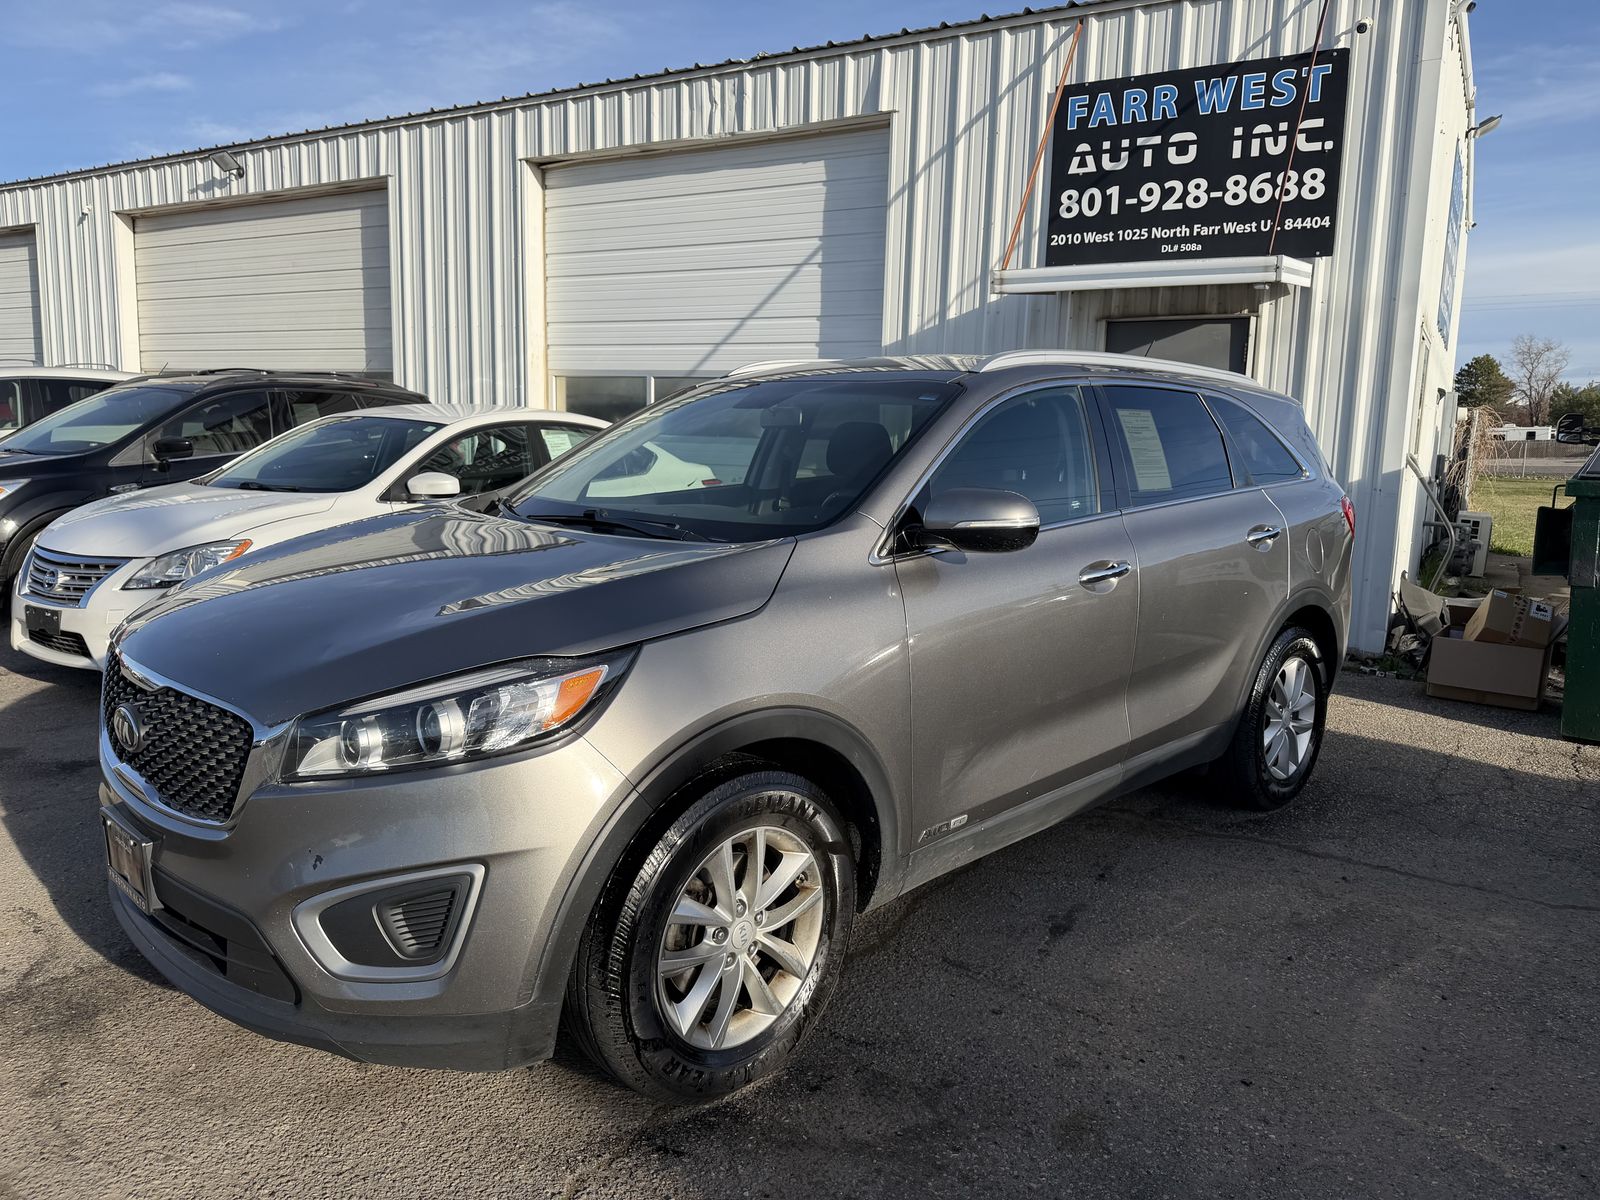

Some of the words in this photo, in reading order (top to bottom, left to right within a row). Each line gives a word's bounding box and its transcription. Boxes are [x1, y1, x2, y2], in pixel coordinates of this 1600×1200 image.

[1067, 84, 1178, 130] FARR
[1194, 64, 1333, 115] WEST
[1067, 131, 1198, 175] AUTO
[1058, 167, 1326, 219] 801-928-8688
[1050, 232, 1081, 246] 2010
[1083, 231, 1114, 244] West
[1117, 228, 1148, 241] 1025
[1151, 224, 1191, 239] North
[1193, 222, 1221, 237] Farr
[1223, 220, 1257, 234] West
[1260, 219, 1281, 232] U.
[1284, 215, 1331, 231] 84404
[1161, 244, 1178, 253] DL#
[1180, 243, 1202, 252] 508a
